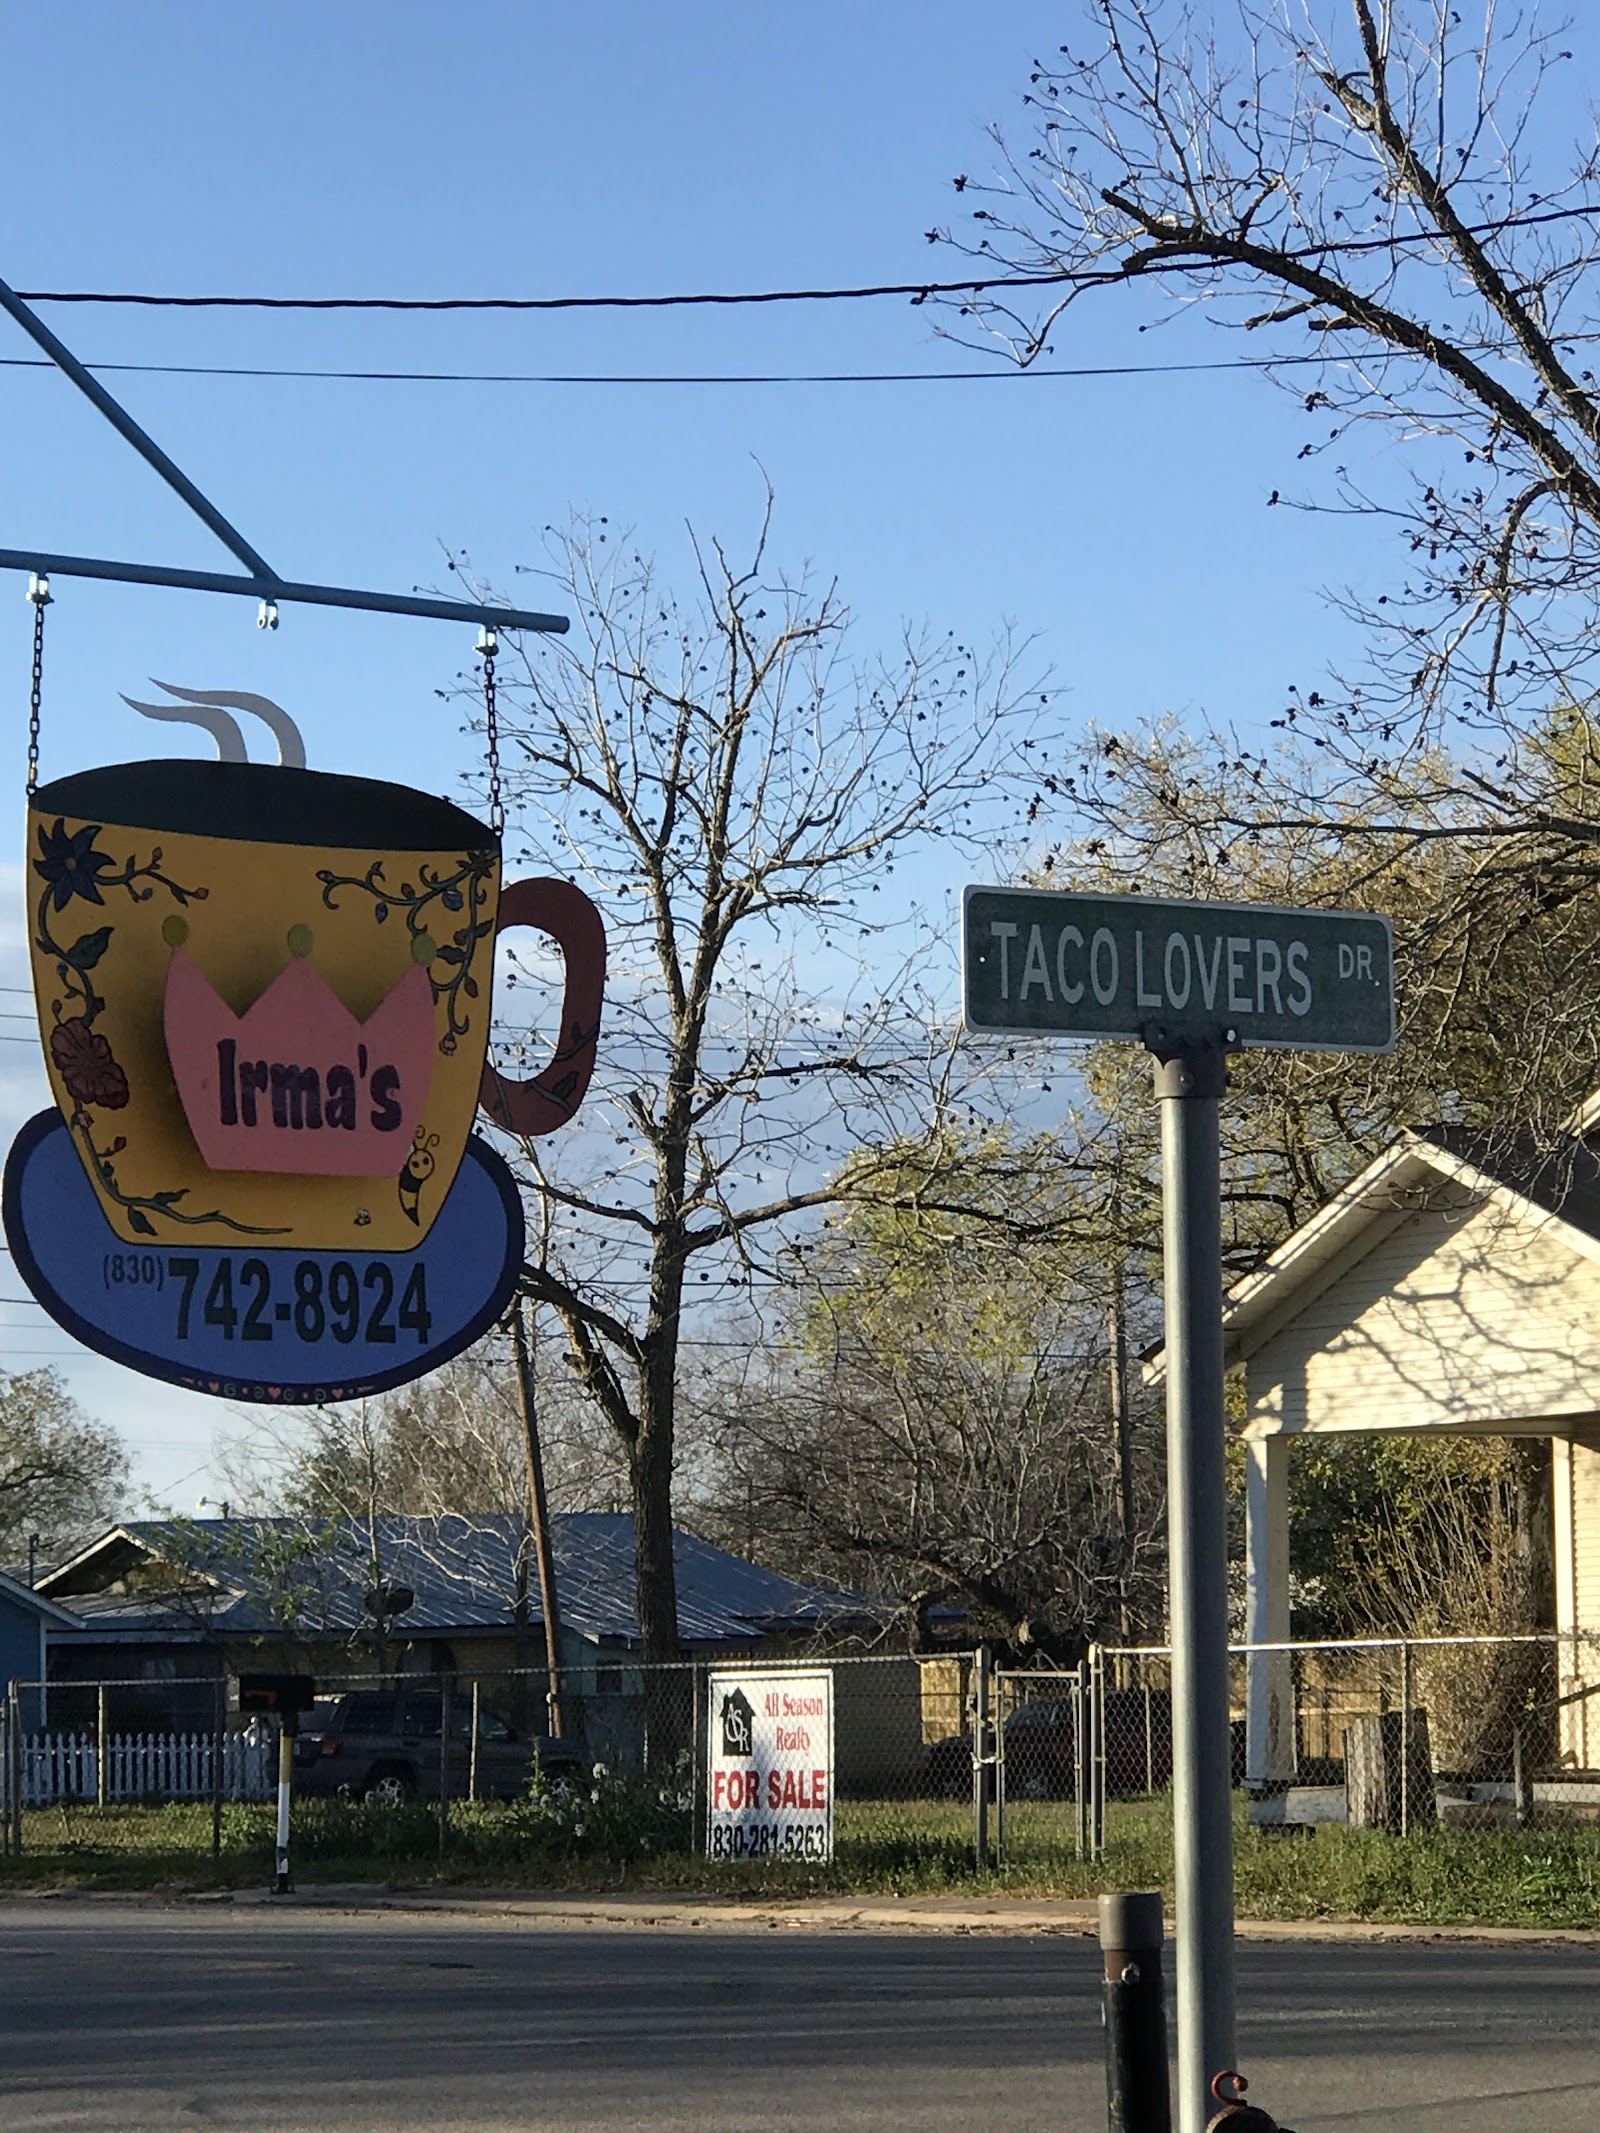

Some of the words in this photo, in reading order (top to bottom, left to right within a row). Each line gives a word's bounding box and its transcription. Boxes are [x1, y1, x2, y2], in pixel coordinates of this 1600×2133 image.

[990, 921, 1119, 1006] TACO
[1136, 930, 1313, 1016] LOVERS
[1338, 943, 1373, 980] DR
[216, 1038, 403, 1132] Irma's
[102, 1253, 165, 1290] (830)
[168, 1256, 433, 1345] 742-8924
[764, 1692, 780, 1718] All
[782, 1692, 824, 1717] Season
[776, 1725, 811, 1757] Realty
[713, 1770, 761, 1810] FOR
[767, 1769, 826, 1810] SALE
